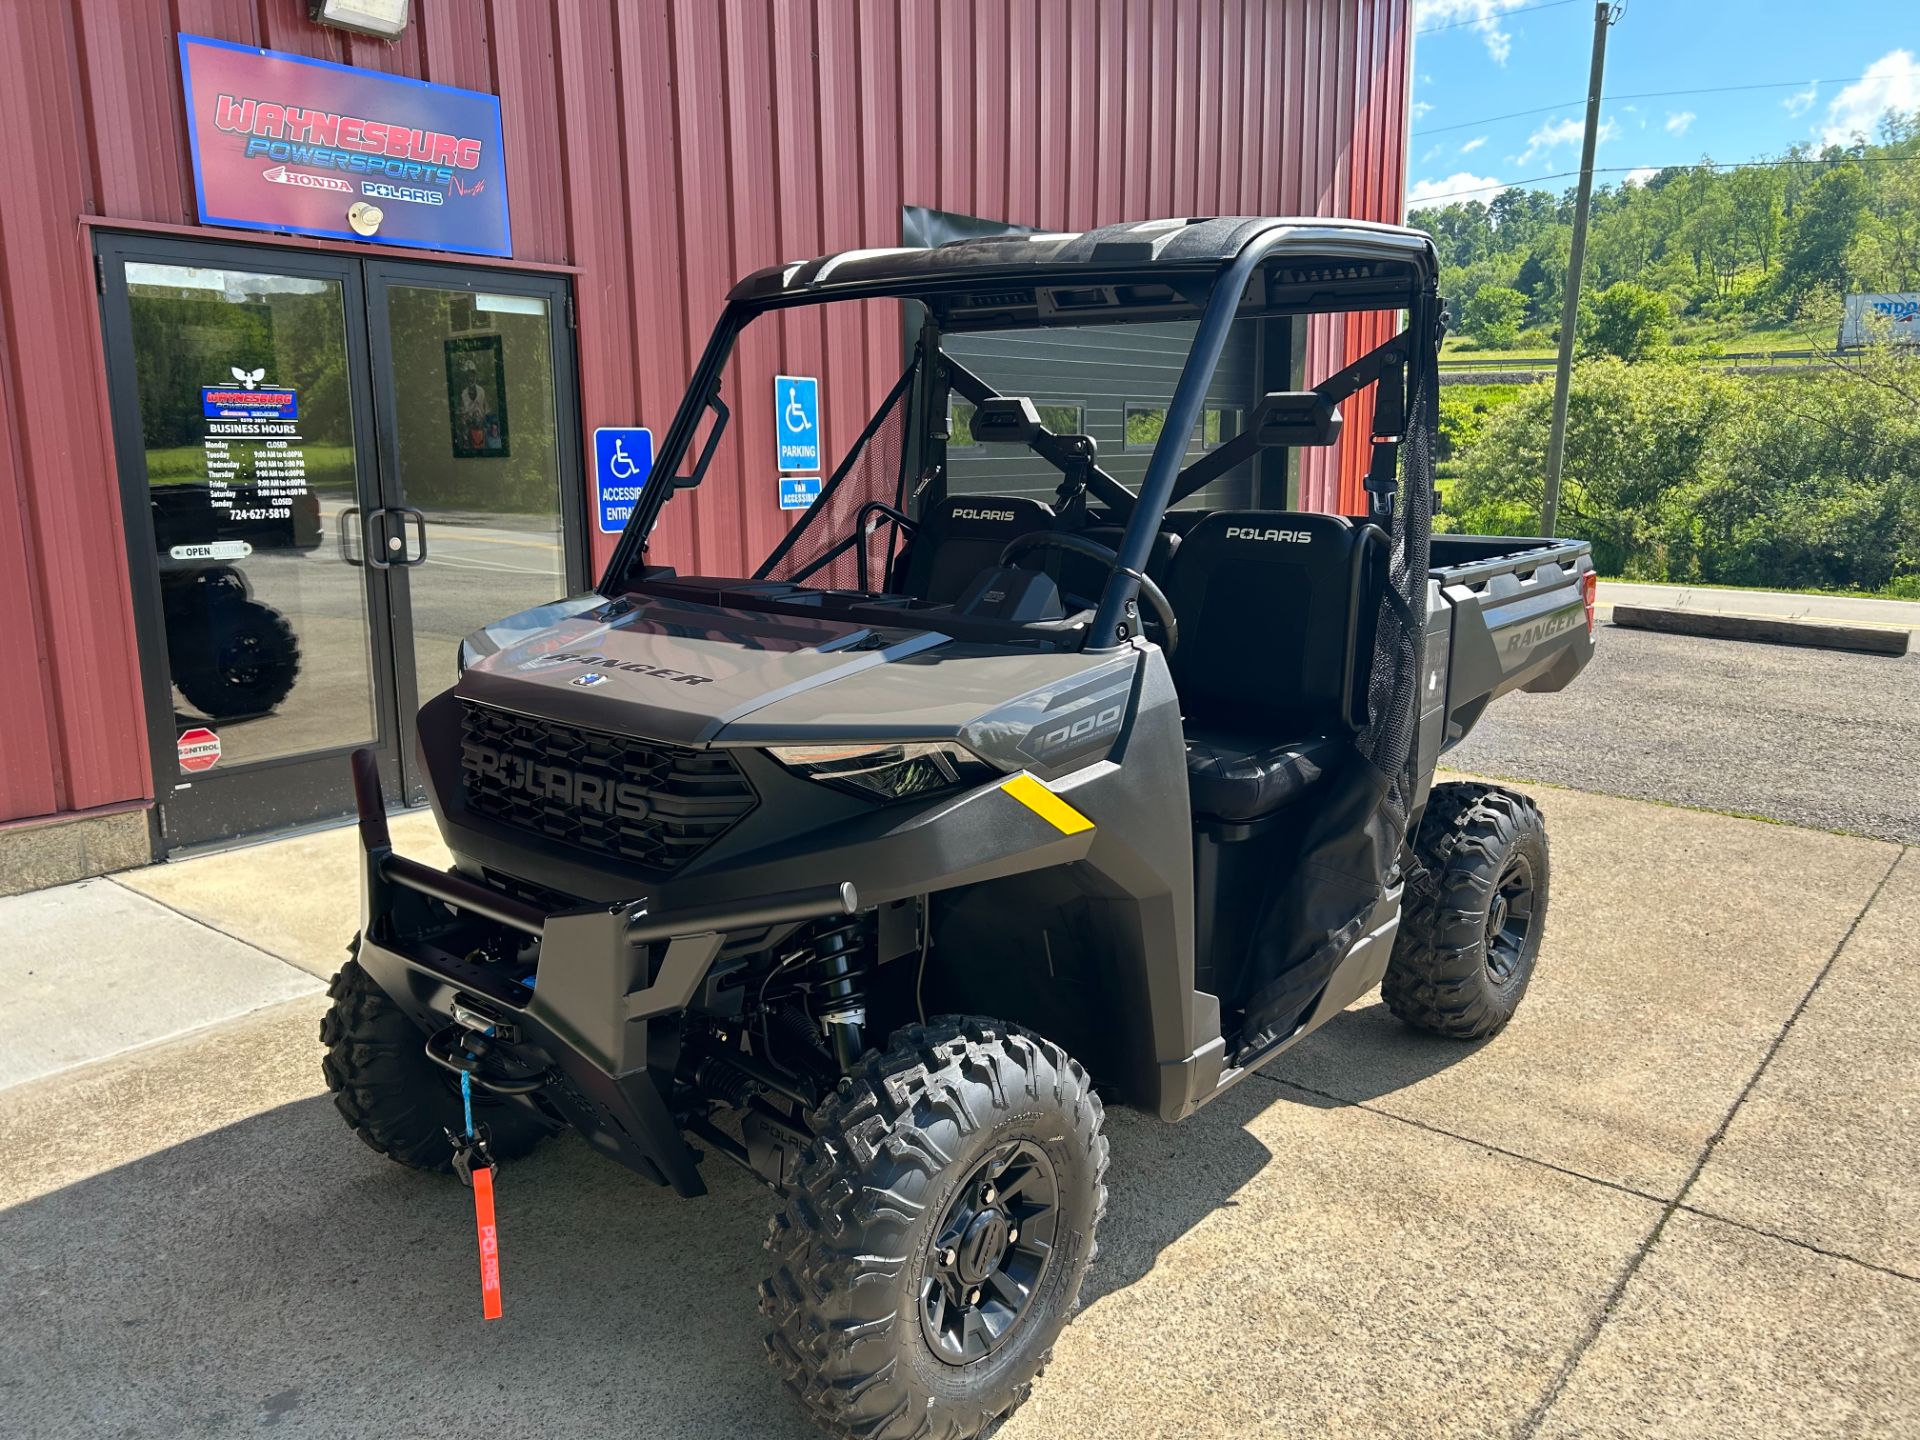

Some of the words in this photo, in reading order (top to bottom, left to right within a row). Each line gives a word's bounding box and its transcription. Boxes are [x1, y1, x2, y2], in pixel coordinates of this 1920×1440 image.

[214, 95, 482, 169] WAYNESBURG
[246, 137, 453, 184] POWERSPORTS
[286, 173, 351, 191] HONDA
[363, 183, 443, 204] POLARIS
[206, 392, 293, 404] WAYNESBURG
[209, 424, 260, 433] BUSINESS
[261, 425, 296, 434] HOURS
[205, 441, 229, 450] Monday
[266, 441, 288, 449] CLOSED
[781, 445, 816, 457] PARKING
[206, 451, 230, 460] Tuesday
[207, 461, 240, 470] Wednesday
[255, 460, 268, 468] 9:00
[208, 470, 235, 479] Thursday
[209, 480, 228, 489] Friday
[270, 479, 280, 487] AM
[280, 479, 286, 487] to
[793, 483, 807, 493] VAN
[210, 490, 236, 499] Saturday
[602, 486, 643, 501] ACCESSIB
[211, 500, 233, 509] Sunday
[271, 498, 293, 506] CLOSED
[229, 508, 291, 520] 724-627-5819
[606, 506, 634, 521] ENTRA
[952, 508, 1015, 521] POLARIS
[1225, 527, 1312, 543] POLARIS
[186, 547, 211, 557] OPEN
[1506, 613, 1577, 653] RANGER
[542, 652, 714, 686] RANGER
[1032, 704, 1121, 755] 1000
[178, 744, 219, 755] SONITROL
[476, 745, 651, 821] POLARIS
[481, 1225, 499, 1290] POLARIS
